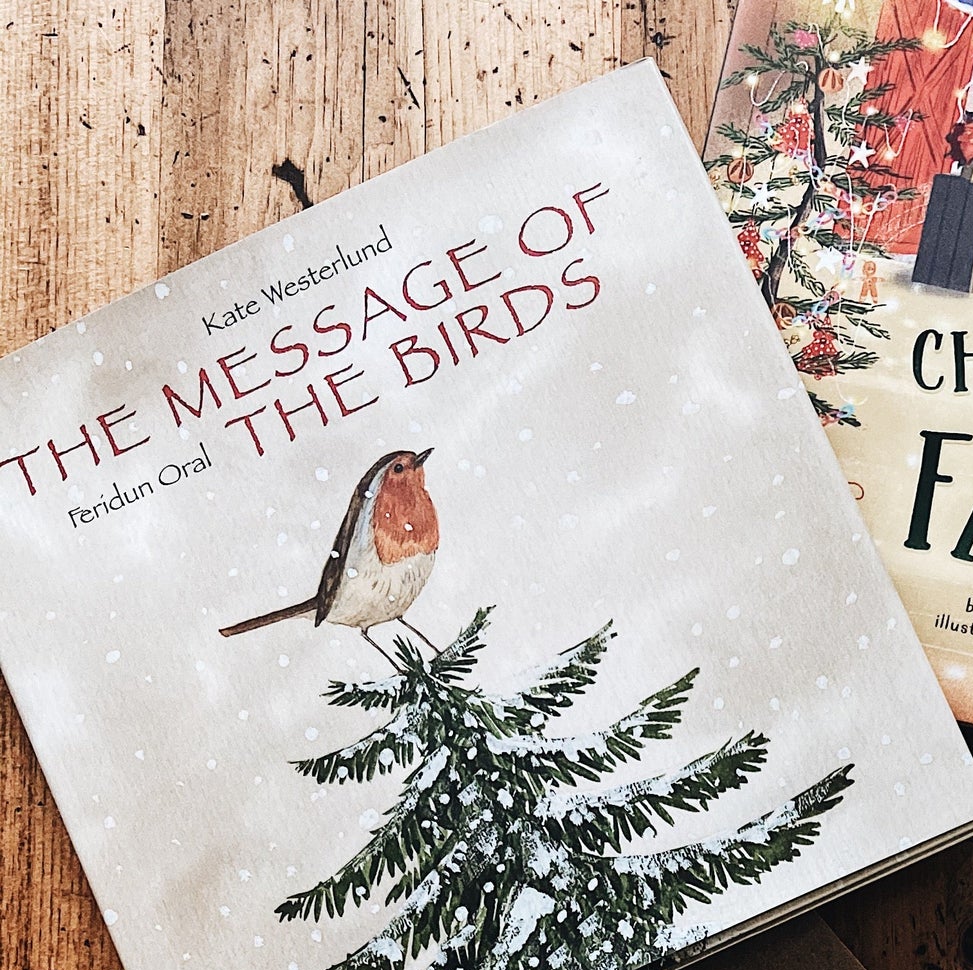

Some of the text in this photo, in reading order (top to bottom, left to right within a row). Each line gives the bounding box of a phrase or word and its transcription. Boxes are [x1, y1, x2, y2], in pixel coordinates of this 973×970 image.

[0, 182, 609, 497] THE MESSAGE OF
[201, 224, 393, 336] Kate Westerlund
[225, 258, 601, 457] THE BIRDS
[67, 441, 212, 529] Feridun Oral
